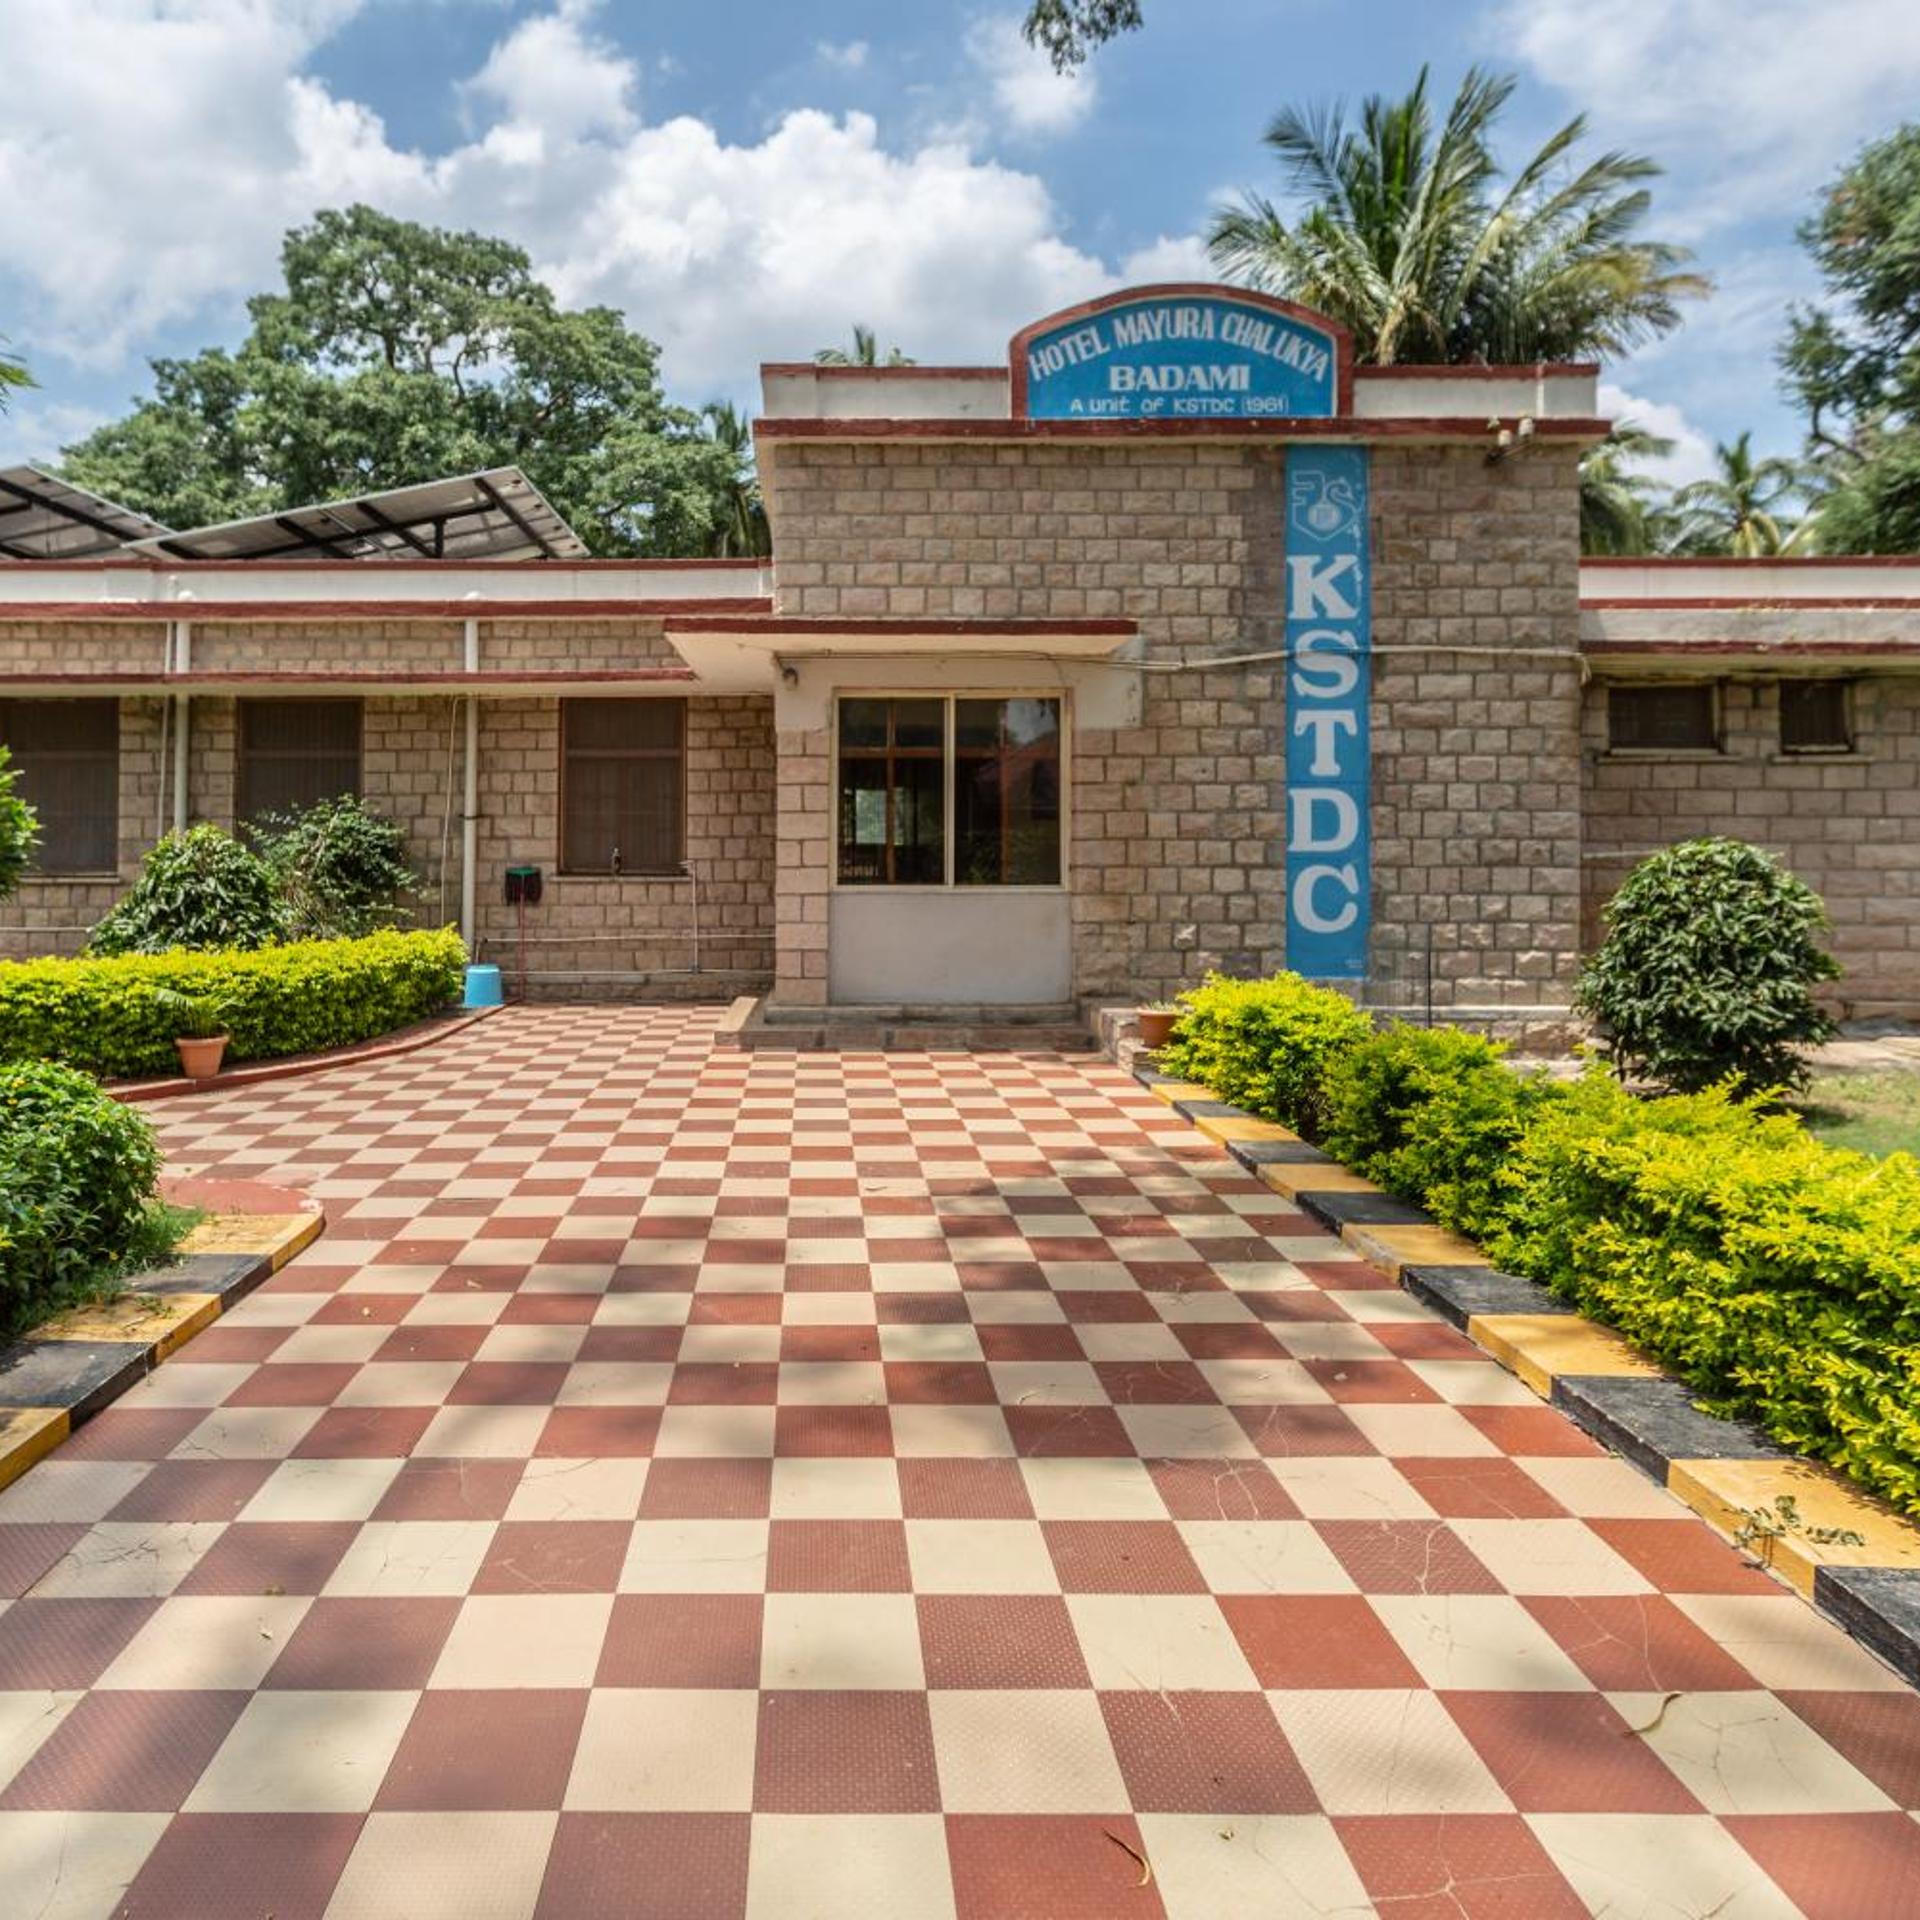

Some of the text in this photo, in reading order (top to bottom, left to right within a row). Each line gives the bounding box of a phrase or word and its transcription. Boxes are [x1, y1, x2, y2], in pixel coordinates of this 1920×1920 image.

[1029, 307, 1329, 382] HOTEL MAYURA CHALUKYA
[1109, 366, 1249, 391] BADAMI
[1070, 398, 1084, 413] A
[1173, 399, 1236, 414] KSTDC
[1286, 556, 1359, 933] KSTDC
